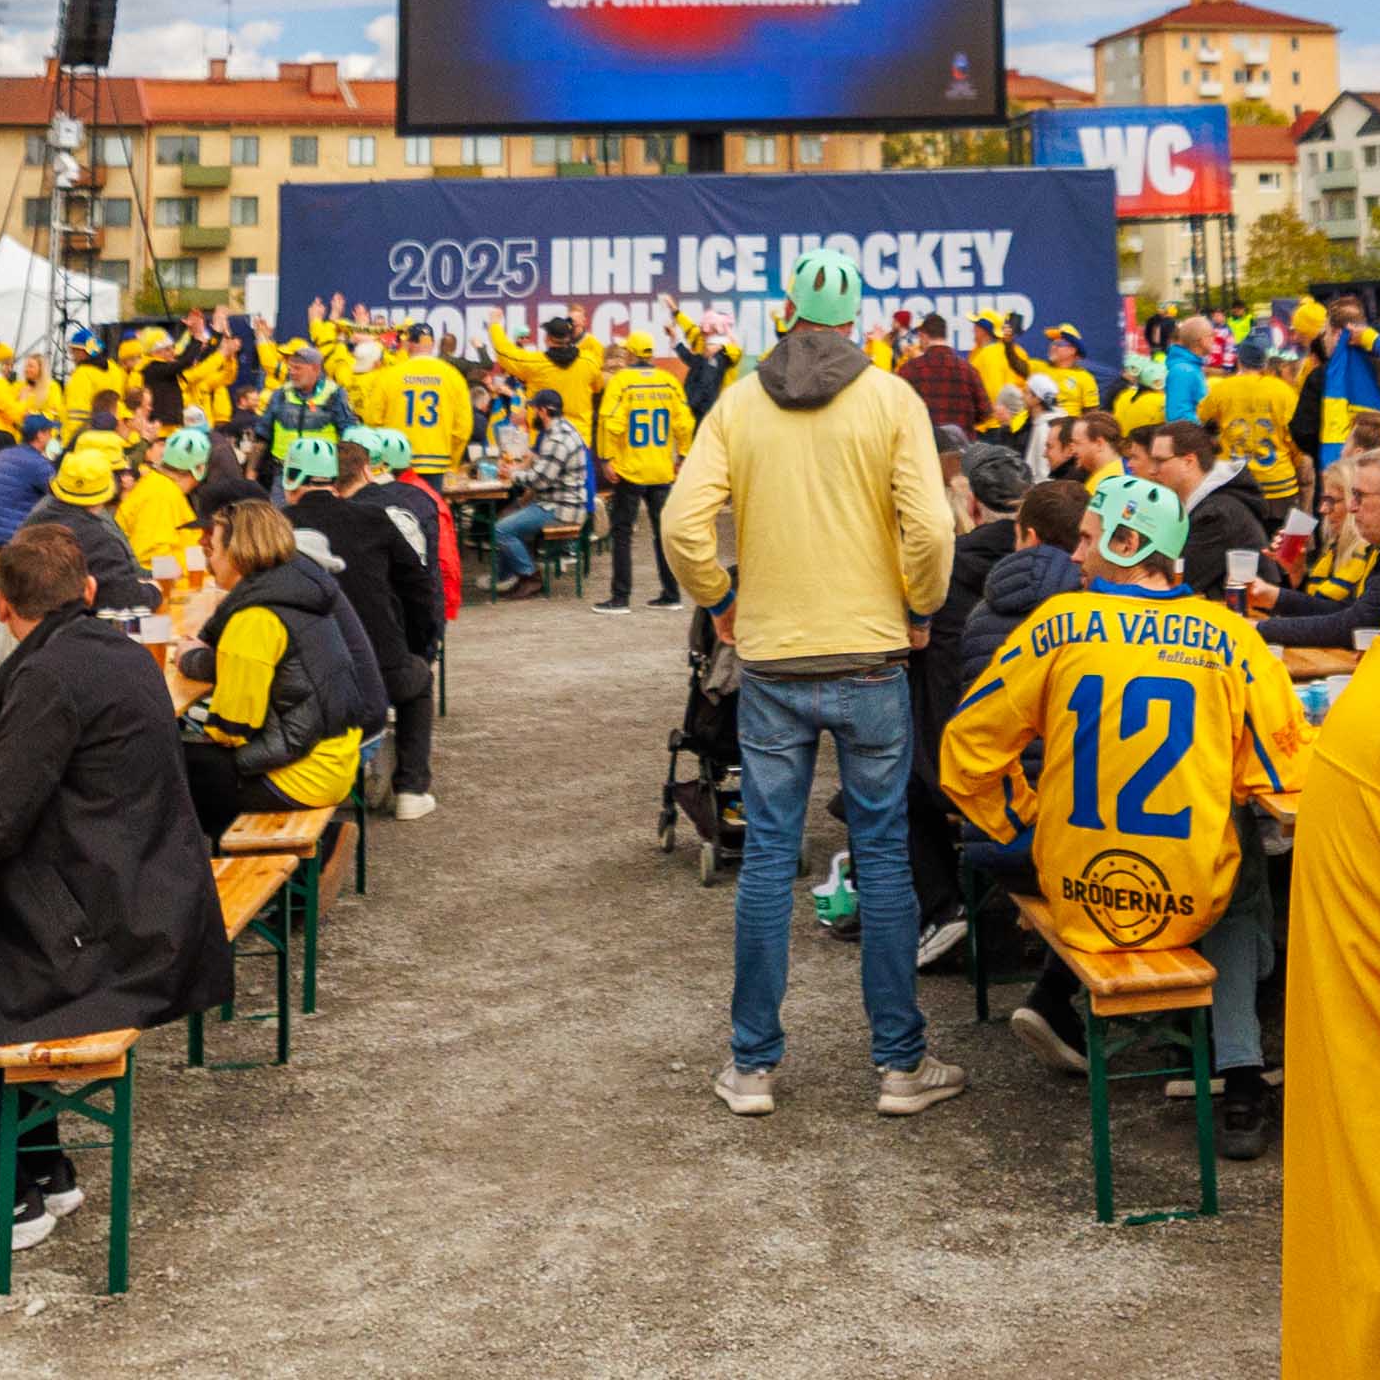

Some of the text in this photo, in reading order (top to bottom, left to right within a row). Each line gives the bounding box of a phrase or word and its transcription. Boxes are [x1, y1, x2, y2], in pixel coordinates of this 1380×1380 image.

[1077, 123, 1196, 197] WC
[388, 240, 538, 300] 2025
[550, 237, 666, 296] IIHF
[678, 235, 769, 293] ICE
[403, 389, 440, 427] 13
[628, 408, 671, 449] 60
[1031, 609, 1236, 667] GULA VÄGGEN
[1067, 674, 1196, 839] 12
[1062, 876, 1195, 916] BRÖDERNAS
